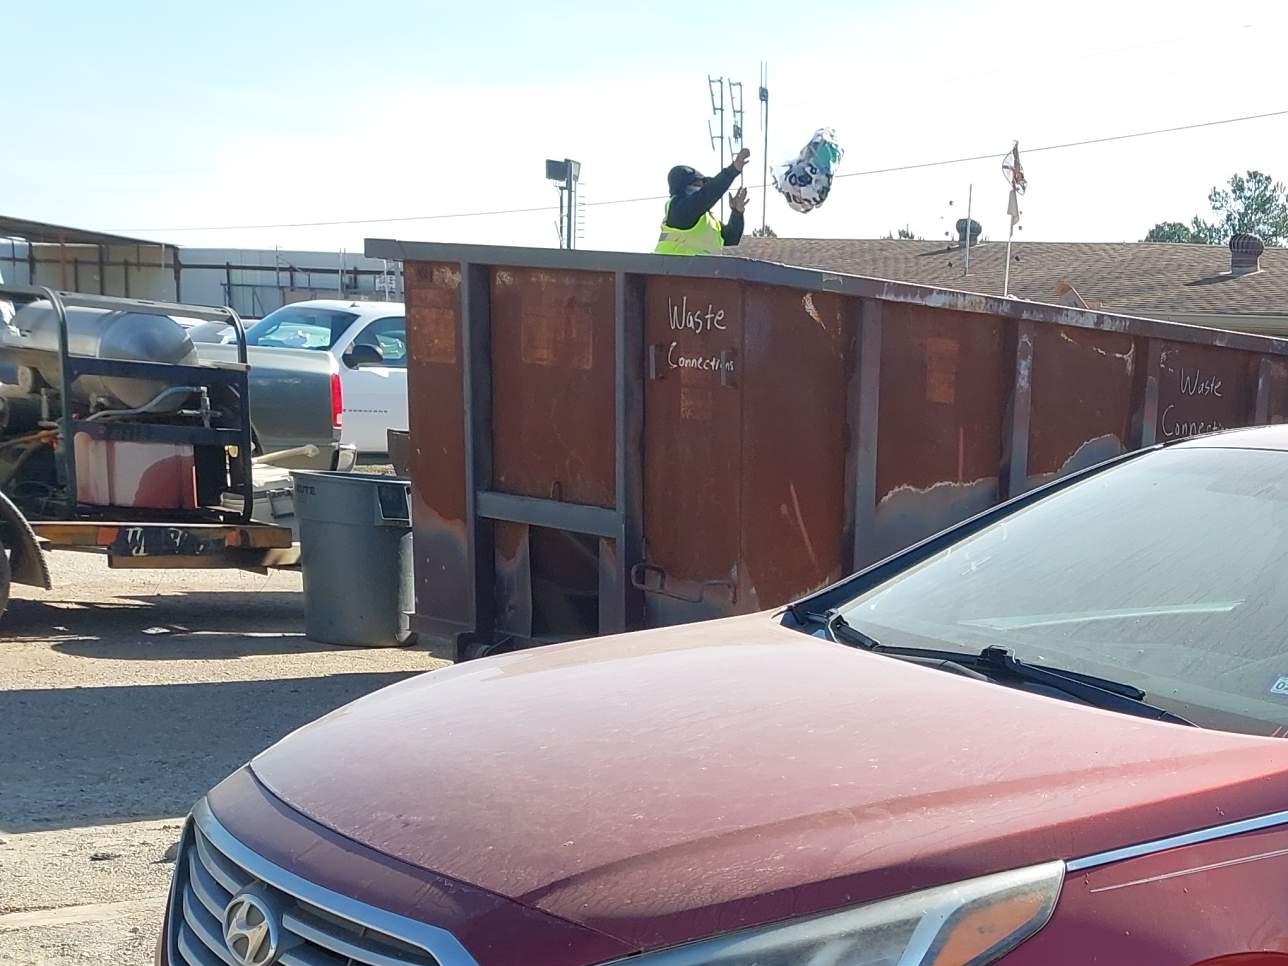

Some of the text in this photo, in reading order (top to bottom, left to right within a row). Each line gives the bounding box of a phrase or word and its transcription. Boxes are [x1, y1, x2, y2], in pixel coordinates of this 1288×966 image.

[667, 295, 728, 335] Waste
[667, 341, 736, 371] Connectins
[1180, 367, 1223, 398] Waste
